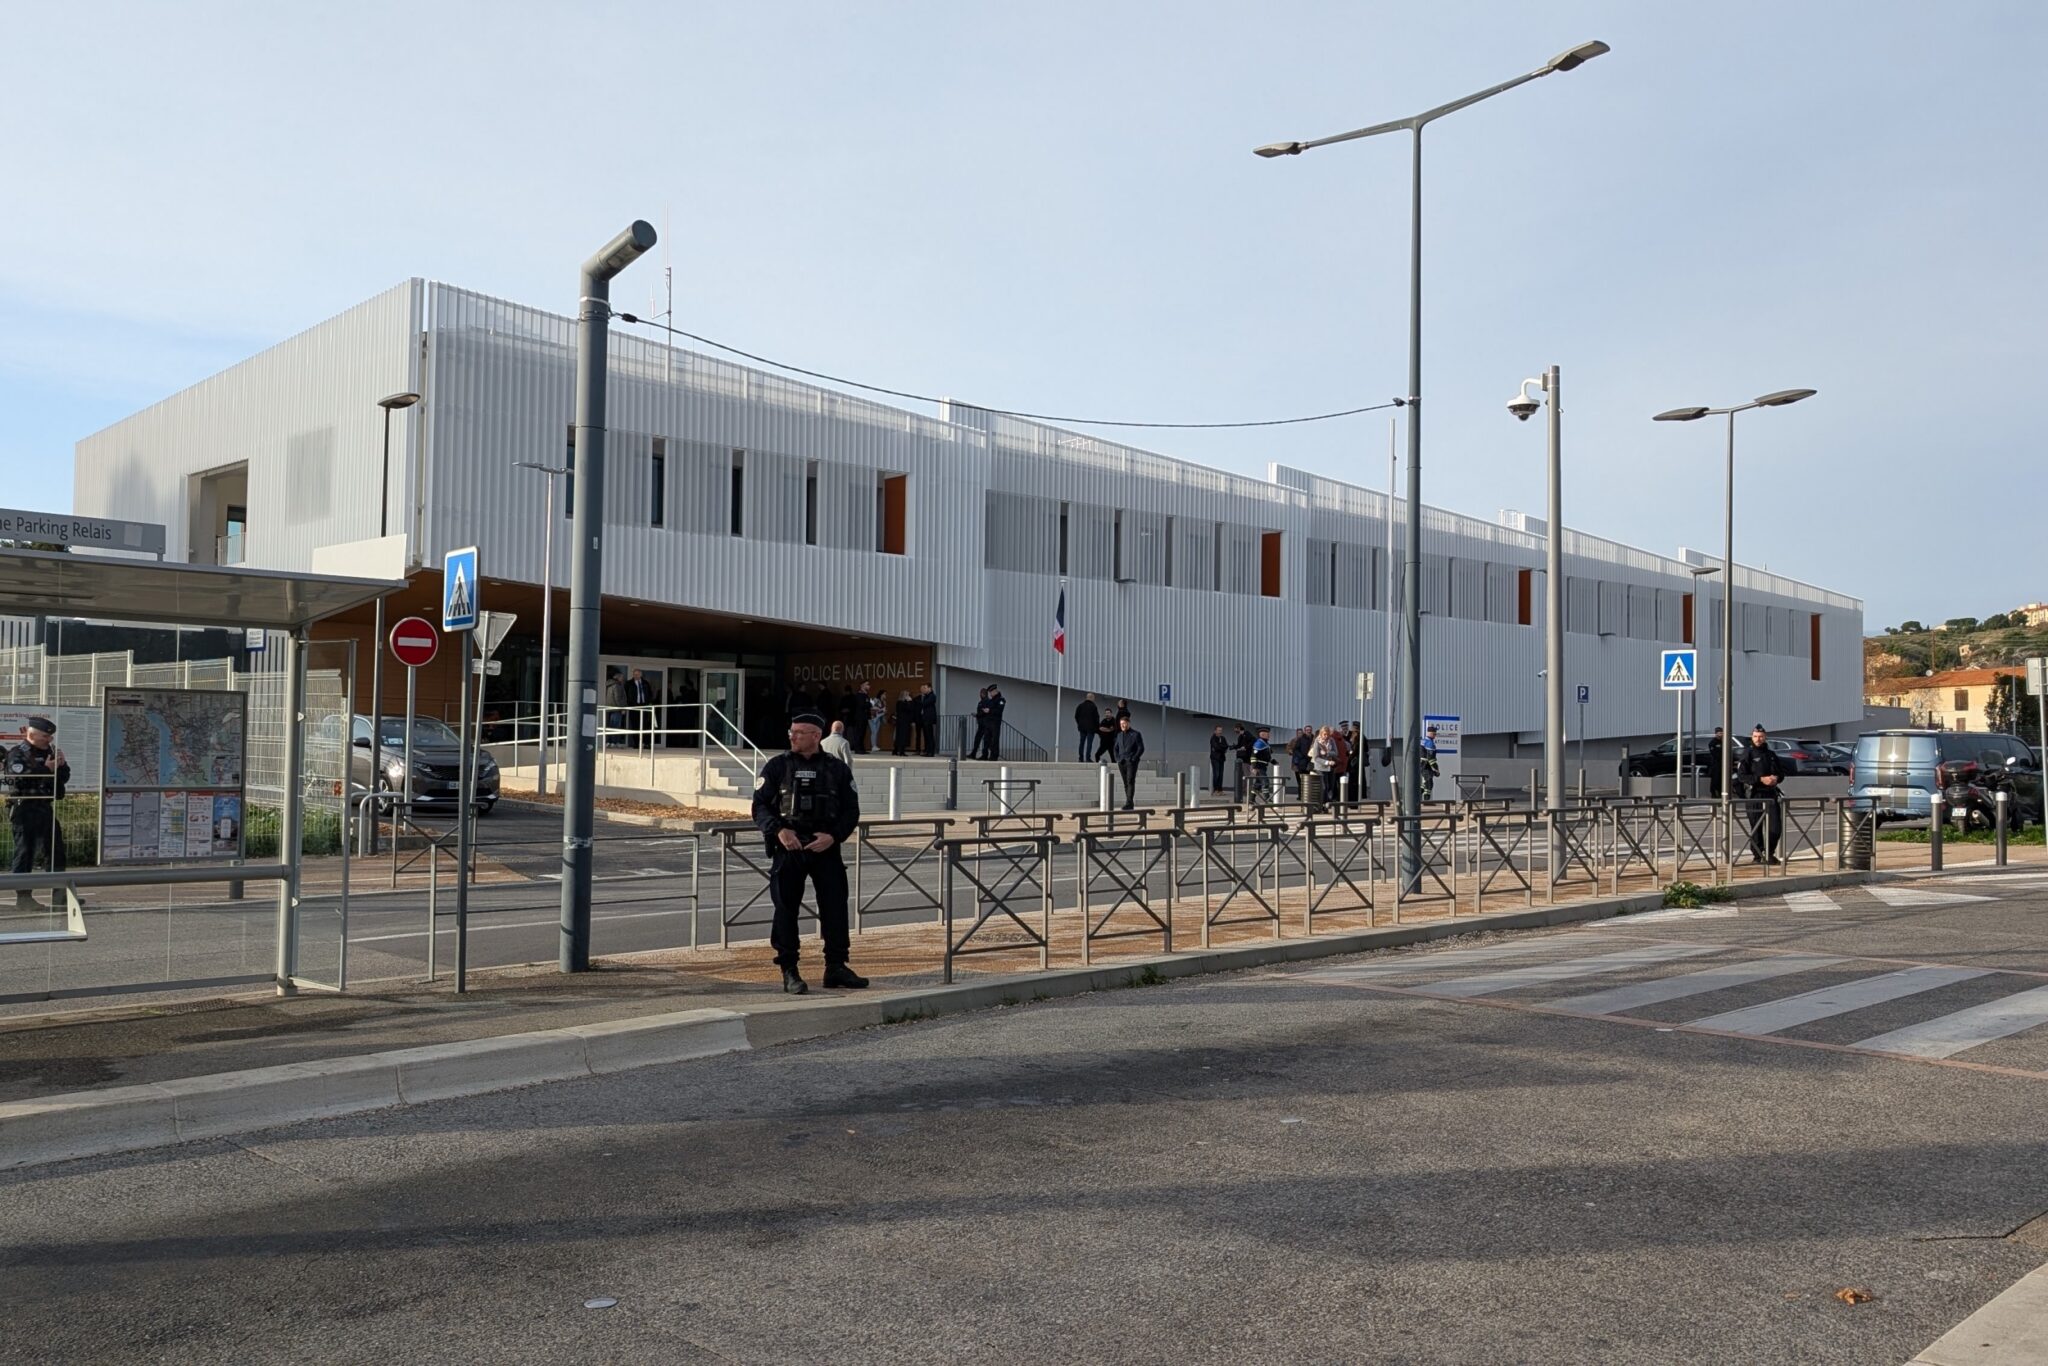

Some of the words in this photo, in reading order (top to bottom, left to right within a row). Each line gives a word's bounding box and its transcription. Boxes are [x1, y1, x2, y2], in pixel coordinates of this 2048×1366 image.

[16, 516, 69, 541] Parking
[72, 521, 112, 541] Relais
[793, 664, 841, 681] POLICE
[845, 661, 925, 680] NATIONALE
[1161, 685, 1168, 697] P
[1579, 687, 1586, 699] P
